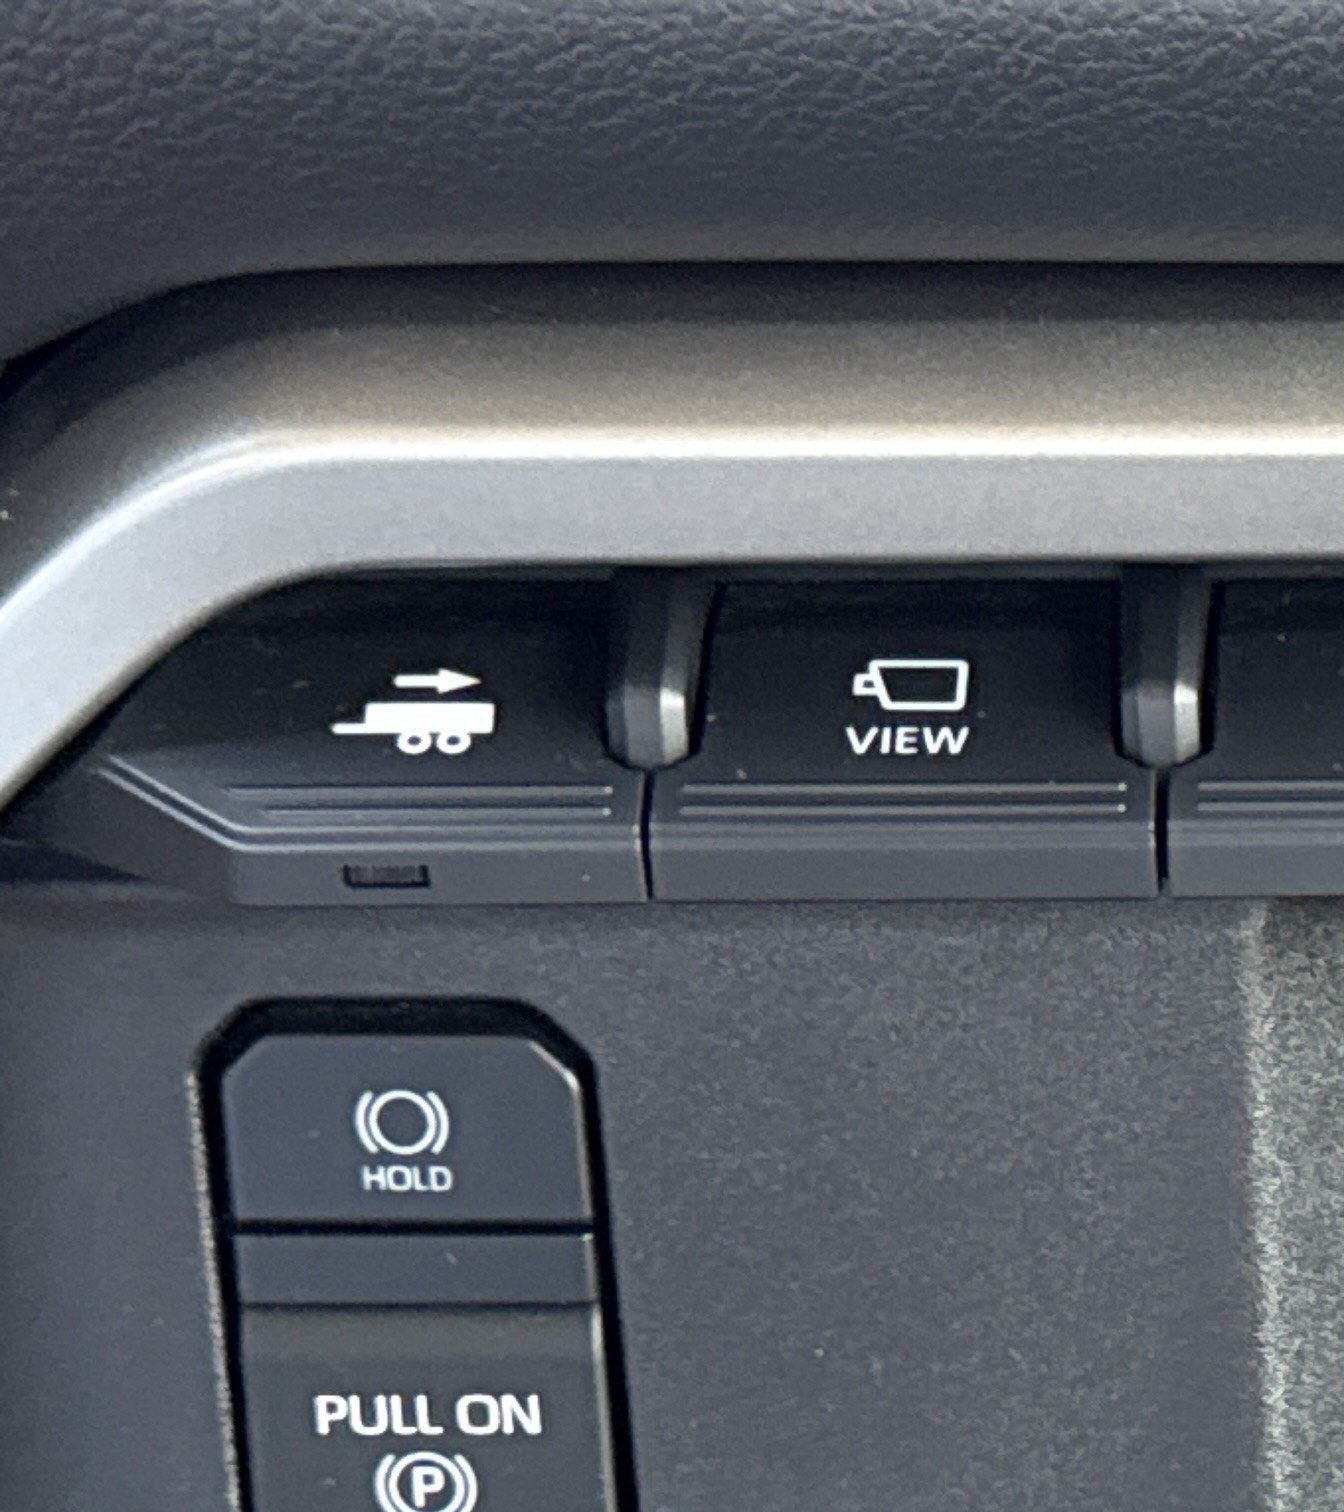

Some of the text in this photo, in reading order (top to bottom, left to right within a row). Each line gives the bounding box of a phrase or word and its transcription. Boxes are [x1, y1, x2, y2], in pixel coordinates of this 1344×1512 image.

[845, 725, 970, 756] VIEW
[362, 1164, 453, 1193] HOLD
[313, 1393, 543, 1436] PULL ON
